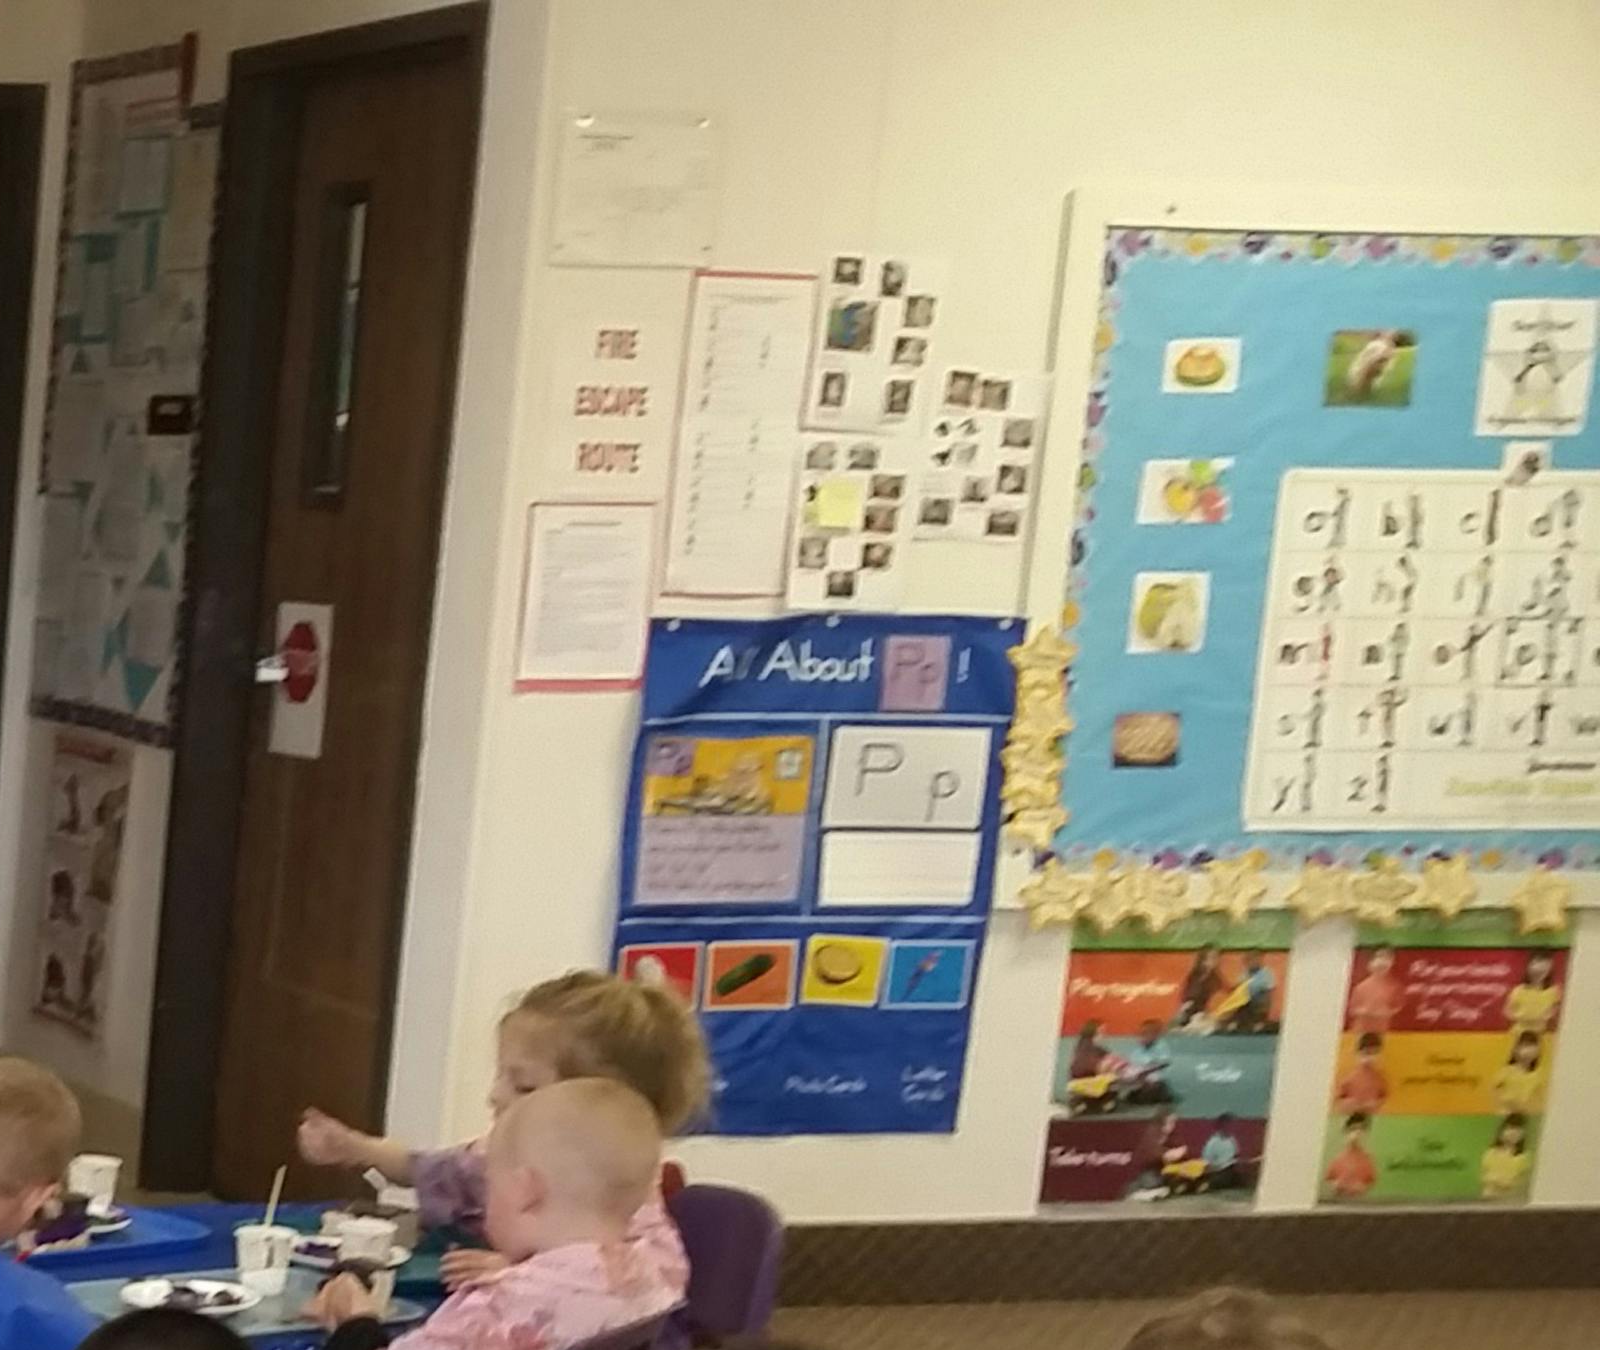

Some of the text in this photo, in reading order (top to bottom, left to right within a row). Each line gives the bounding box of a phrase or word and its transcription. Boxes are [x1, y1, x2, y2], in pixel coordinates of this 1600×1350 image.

[596, 329, 639, 359] FIRE
[574, 386, 649, 417] ESCAPE
[576, 443, 641, 473] ROUTE
[758, 637, 875, 683] About
[855, 742, 962, 823] P p
